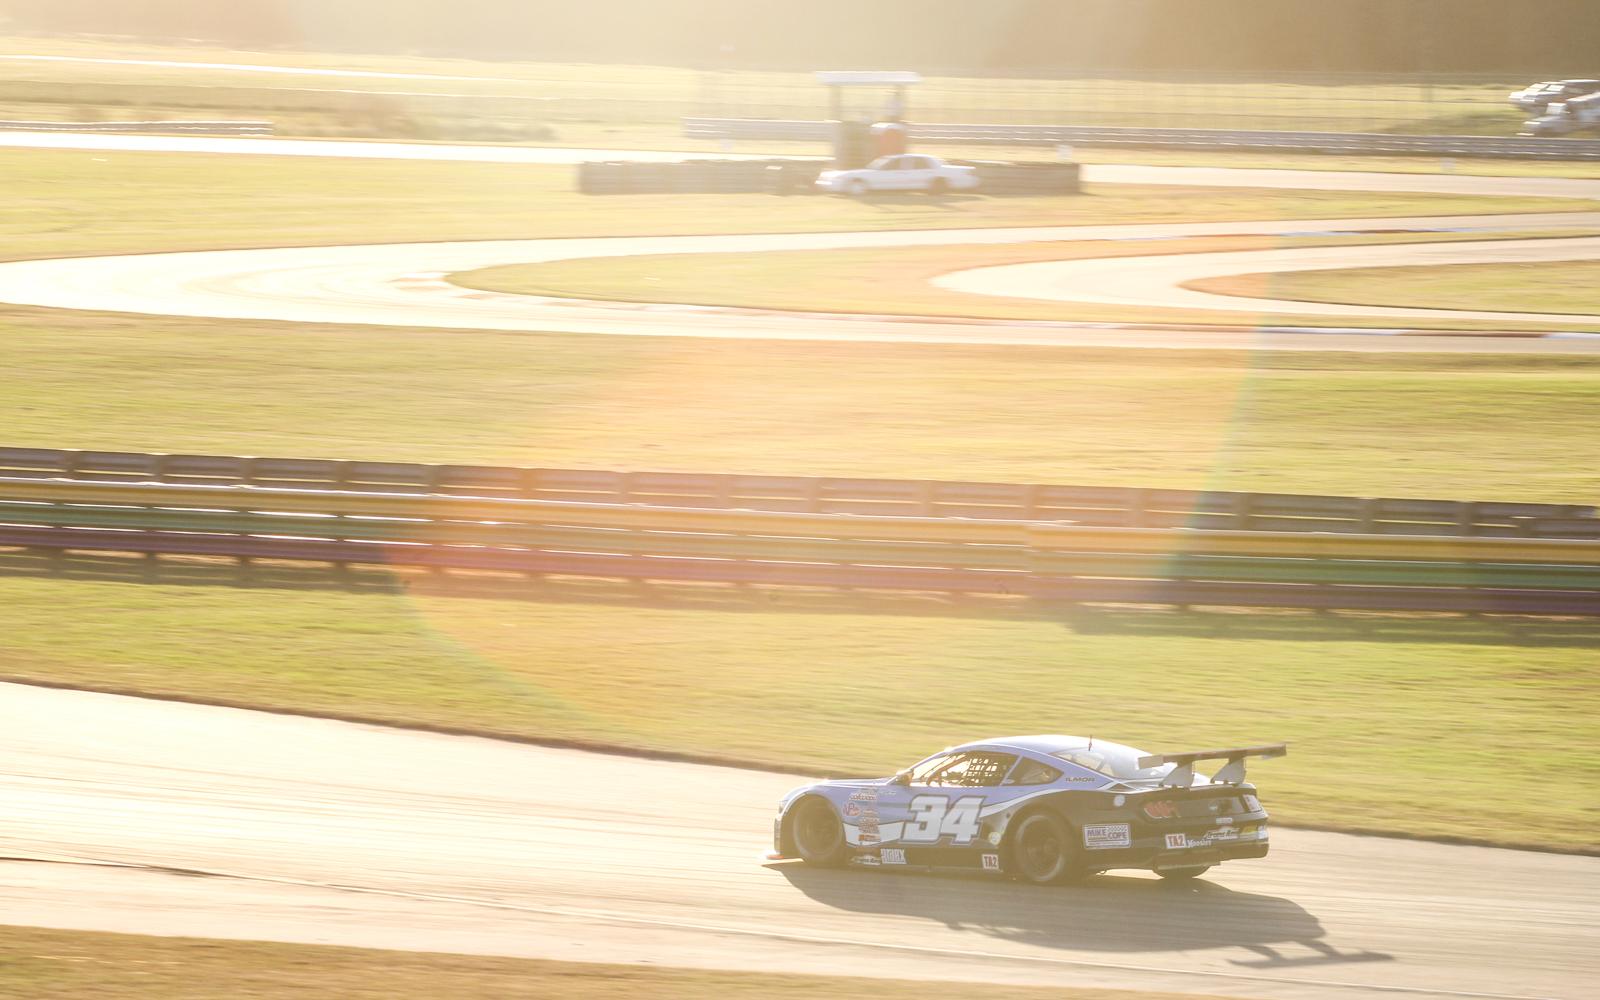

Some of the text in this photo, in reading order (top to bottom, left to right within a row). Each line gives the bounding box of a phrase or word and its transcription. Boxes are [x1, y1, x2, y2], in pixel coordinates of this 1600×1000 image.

[901, 794, 985, 842] 34
[1087, 828, 1107, 837] MIKE
[1107, 831, 1128, 840] COPE
[1167, 835, 1185, 847] TA2
[984, 855, 998, 868] TA2
